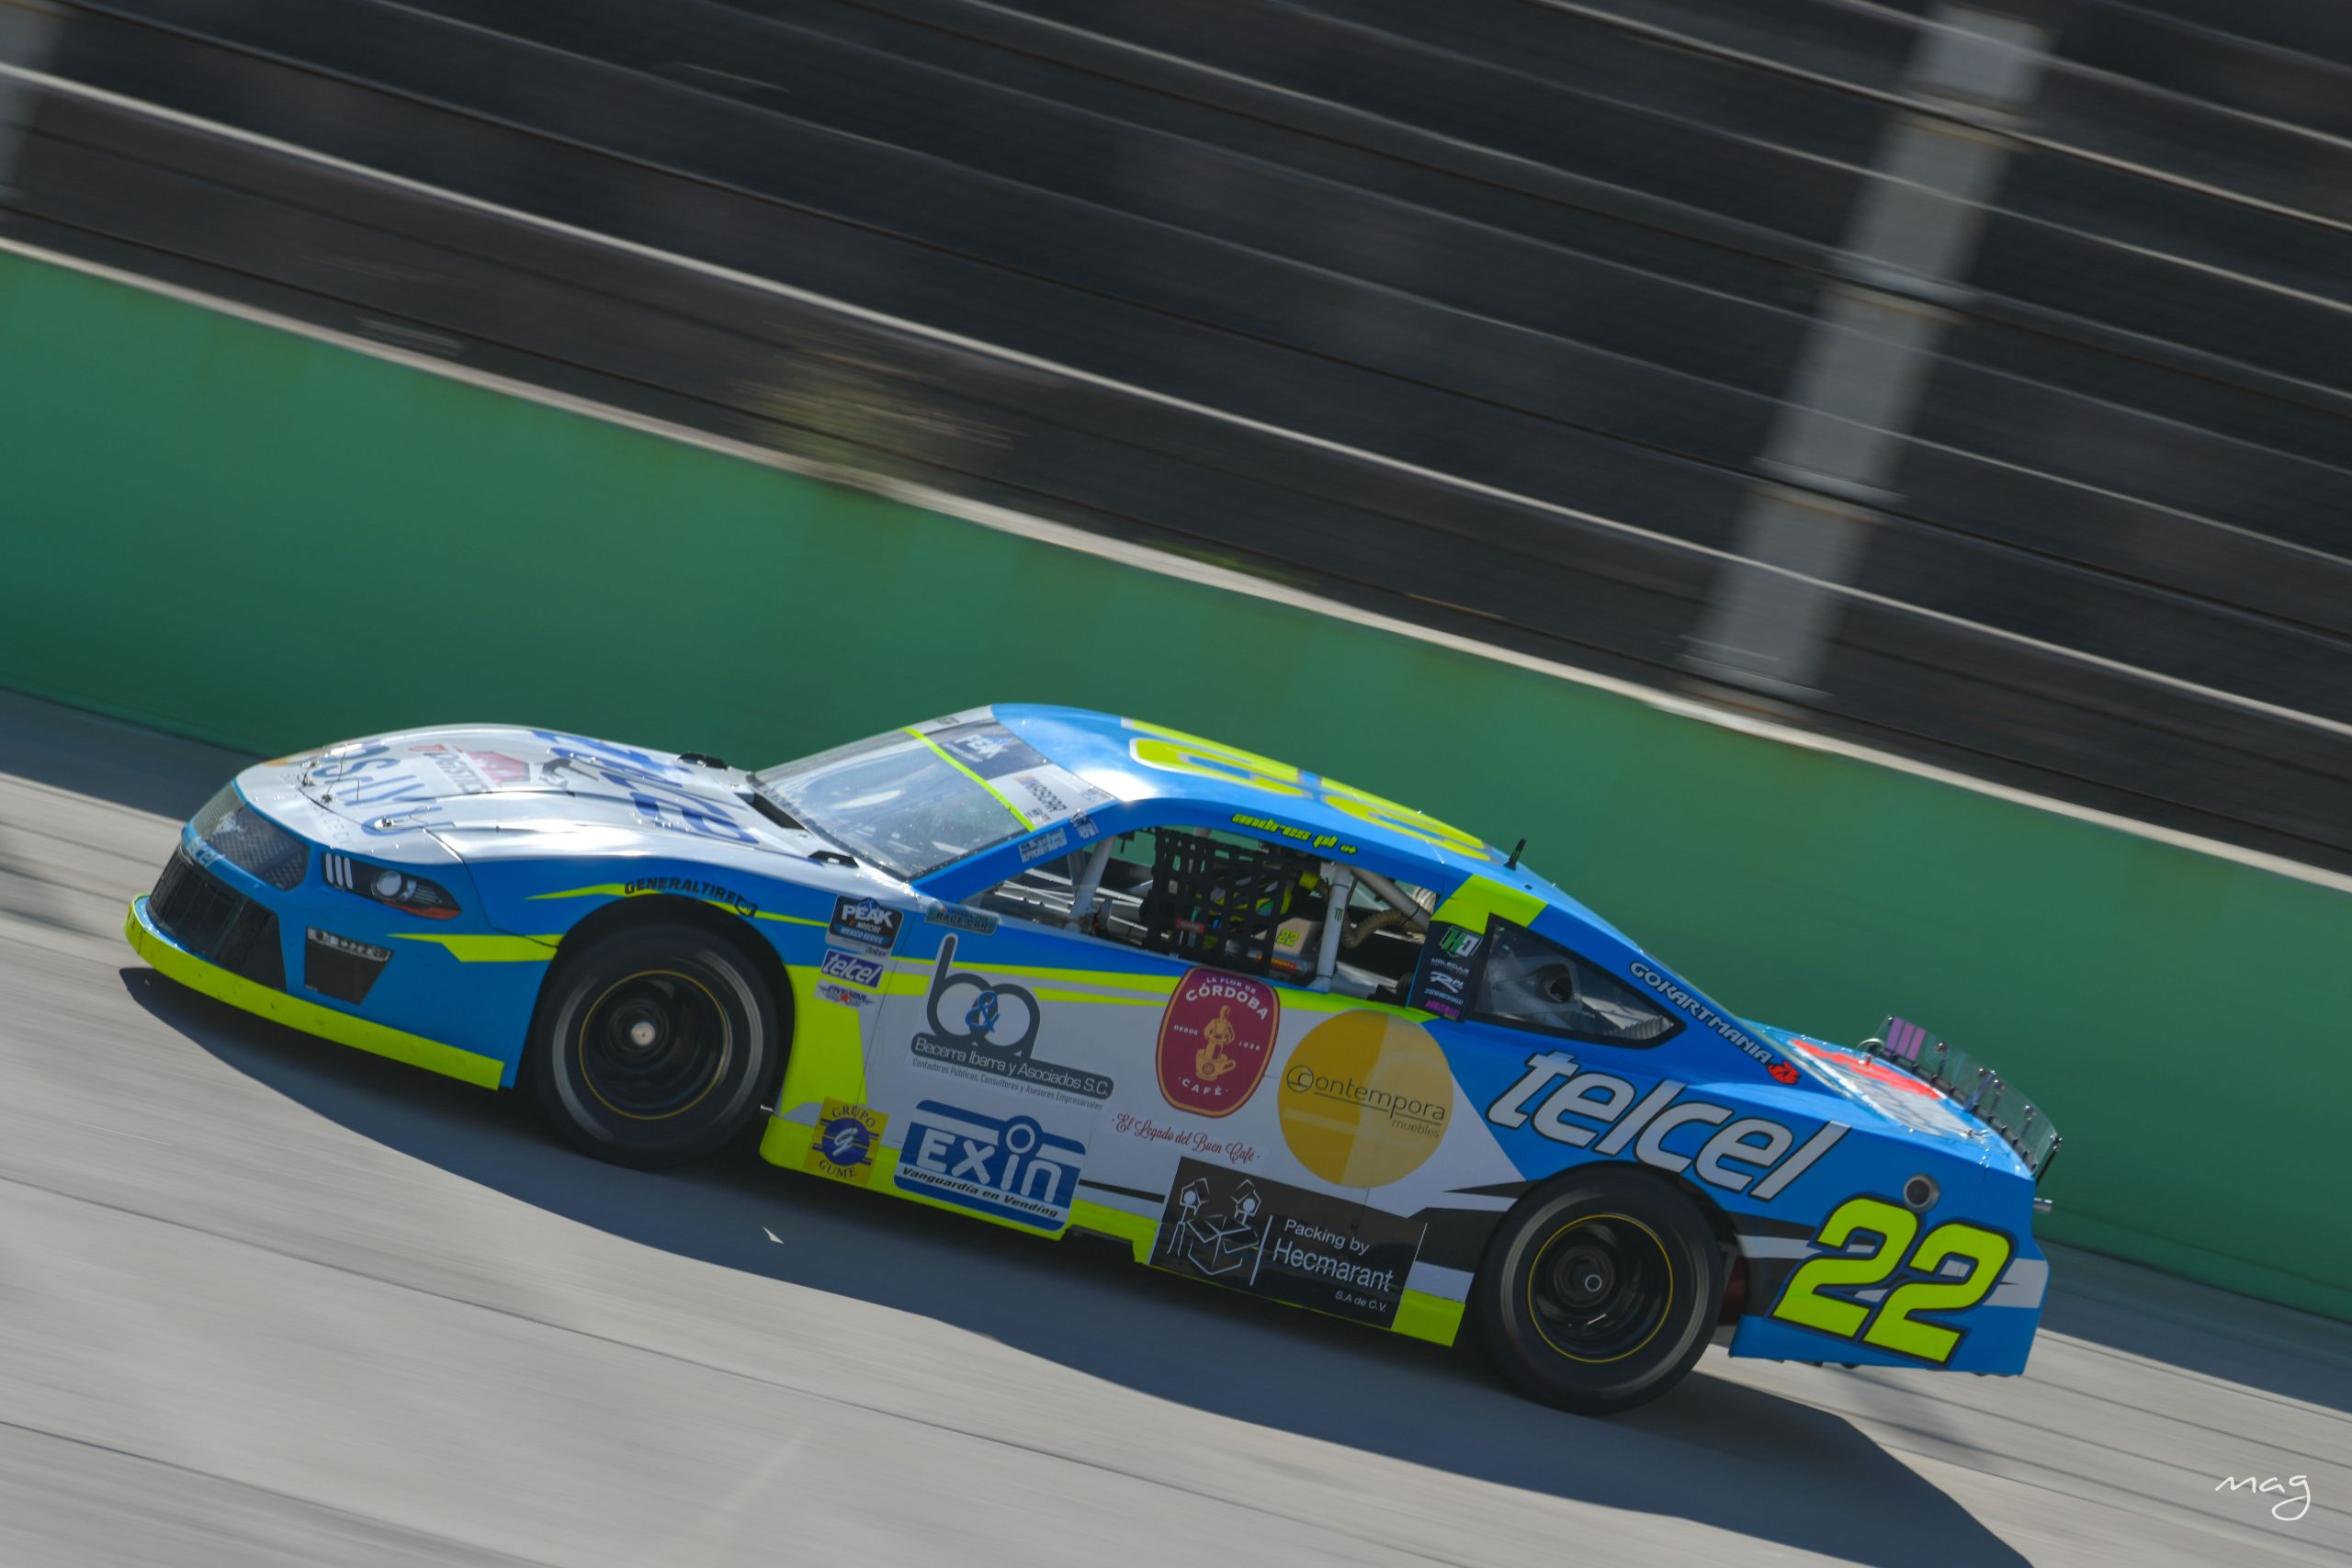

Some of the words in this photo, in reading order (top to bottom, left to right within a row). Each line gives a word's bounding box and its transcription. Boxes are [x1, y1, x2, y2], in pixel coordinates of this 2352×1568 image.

[842, 904, 893, 929] PEAK
[1276, 929, 1300, 947] 22
[824, 953, 882, 987] telcel
[1220, 977, 1242, 987] FLOR
[1245, 985, 1257, 995] DE
[1185, 983, 1269, 1021] CÓRDOBA
[1629, 960, 1772, 1065] GOKARTMANIA
[1173, 1024, 1199, 1035] DESDE
[912, 1057, 949, 1075] Contadores
[980, 1074, 1020, 1091] Consultores
[1024, 1085, 1055, 1100] Asesores
[1056, 1090, 1103, 1111] Empresariales
[915, 1036, 967, 1062] Becerra
[968, 1050, 1006, 1071] Ibarra
[1008, 1061, 1018, 1077] y
[1016, 1062, 1082, 1089] Asociados
[1083, 1077, 1109, 1097] S.C.
[1182, 1078, 1222, 1096] CAFÉ
[1286, 1065, 1446, 1122] Contempora
[831, 1105, 876, 1128] GRUPO
[1391, 1119, 1441, 1140] muebles
[1486, 1050, 1852, 1202] telcel
[1114, 1112, 1133, 1134] El
[1134, 1118, 1173, 1145] Legado
[1175, 1130, 1191, 1146] del
[1192, 1134, 1223, 1156] Buen
[1225, 1140, 1256, 1165] Café
[818, 1160, 858, 1179] GUME
[901, 1166, 979, 1198] Vanguardia
[981, 1190, 1001, 1201] en
[1002, 1191, 1059, 1220] Vending
[1284, 1218, 1346, 1253] Packing
[1349, 1235, 1371, 1257] by
[1272, 1237, 1395, 1293] Hecmarant
[1769, 1194, 2018, 1367] 22
[1354, 1295, 1367, 1307] de
